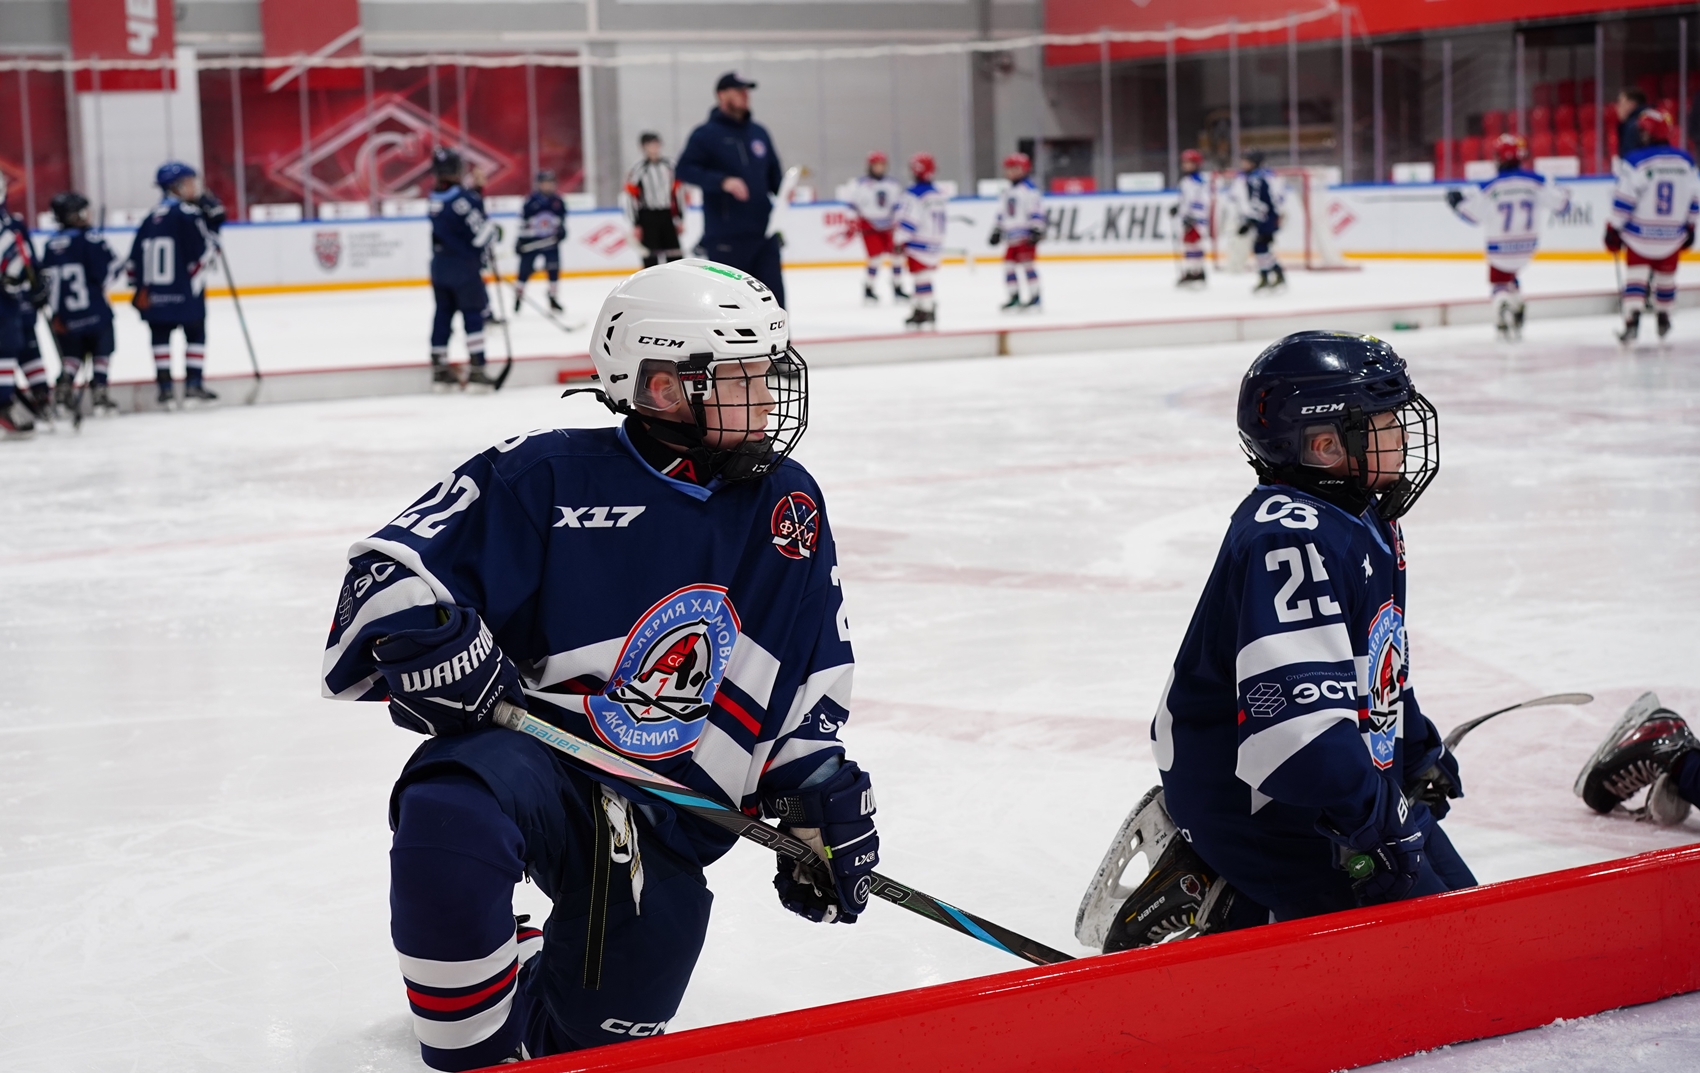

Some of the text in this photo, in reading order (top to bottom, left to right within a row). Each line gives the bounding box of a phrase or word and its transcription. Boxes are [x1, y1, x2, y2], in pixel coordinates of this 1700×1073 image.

[1657, 182, 1683, 215] 9
[1498, 201, 1532, 231] 77
[142, 236, 175, 285] 10
[638, 335, 685, 348] CCM
[1301, 402, 1345, 415] CCM
[389, 472, 481, 539] 22
[552, 505, 647, 528] X17
[779, 519, 815, 547] ФХМ
[622, 602, 687, 669] ВАЛЕРИЯ
[401, 622, 495, 693] WARRIO
[477, 685, 504, 721] ALPHA
[601, 710, 679, 746] АКАДЕМИЯ
